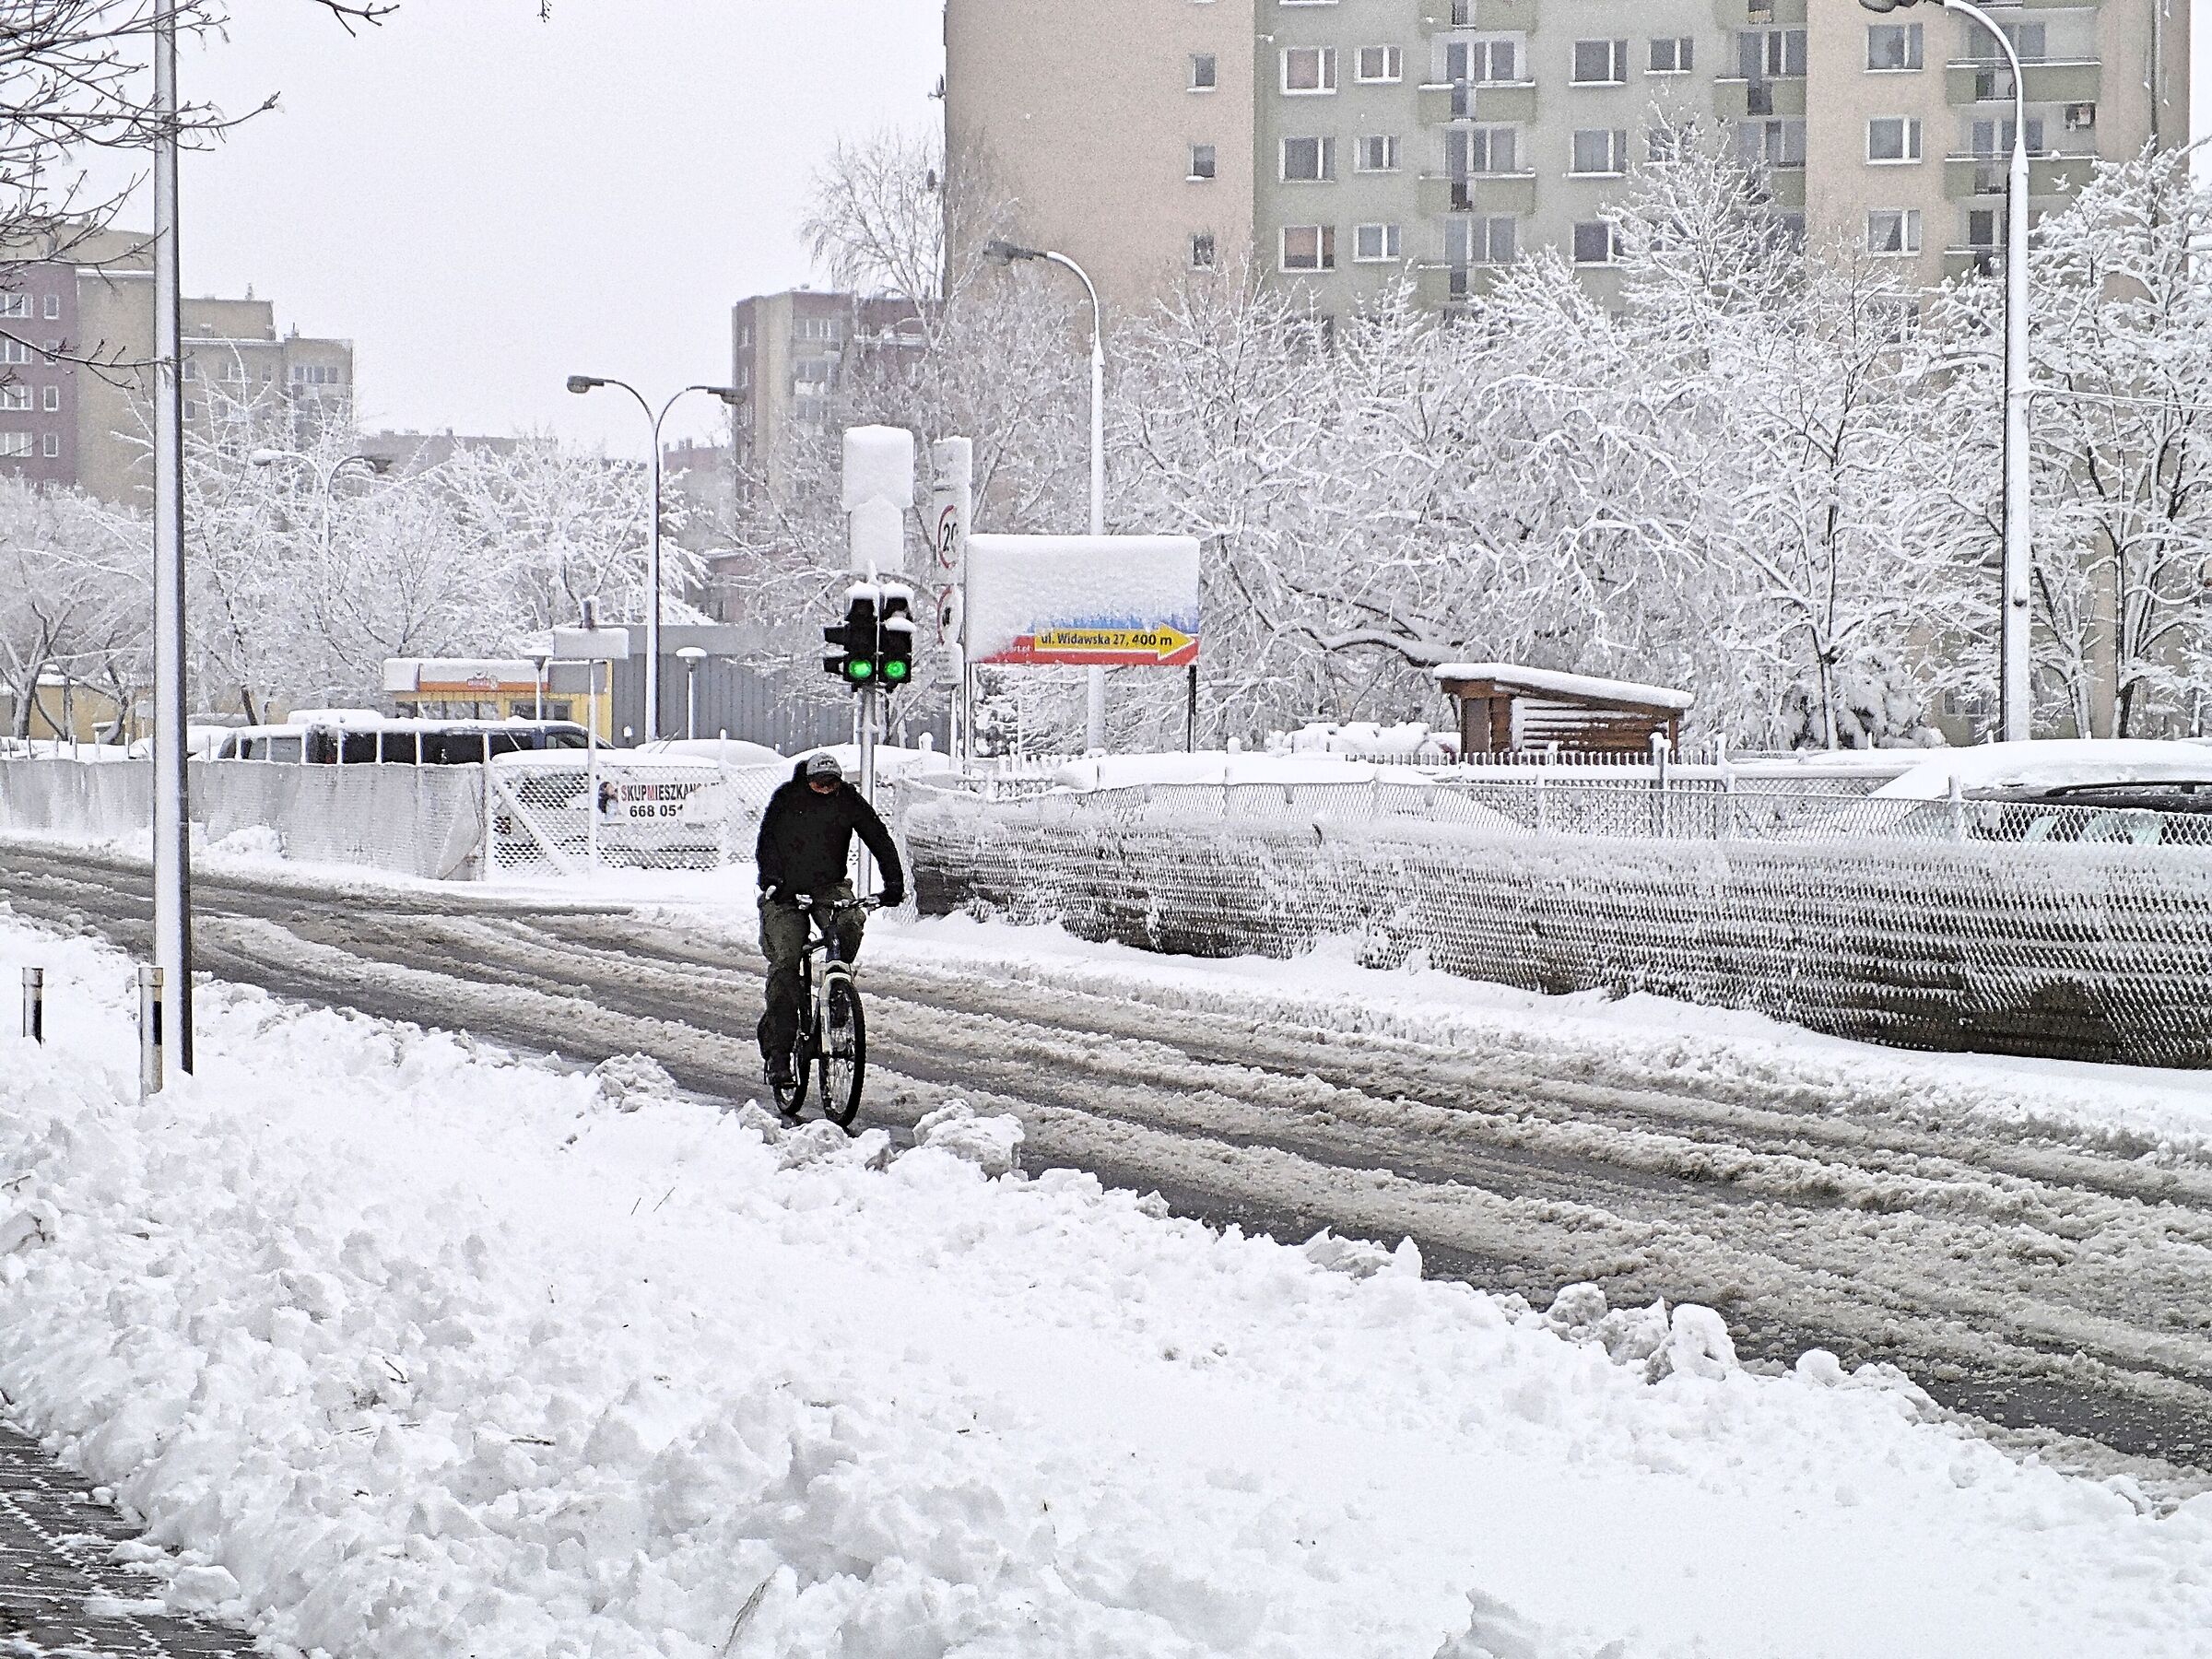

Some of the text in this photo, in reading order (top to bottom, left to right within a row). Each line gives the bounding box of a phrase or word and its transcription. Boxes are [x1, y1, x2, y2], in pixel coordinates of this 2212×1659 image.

[1041, 632, 1172, 646] ul. Widawska 27, 400 m
[629, 805, 655, 817] 668
